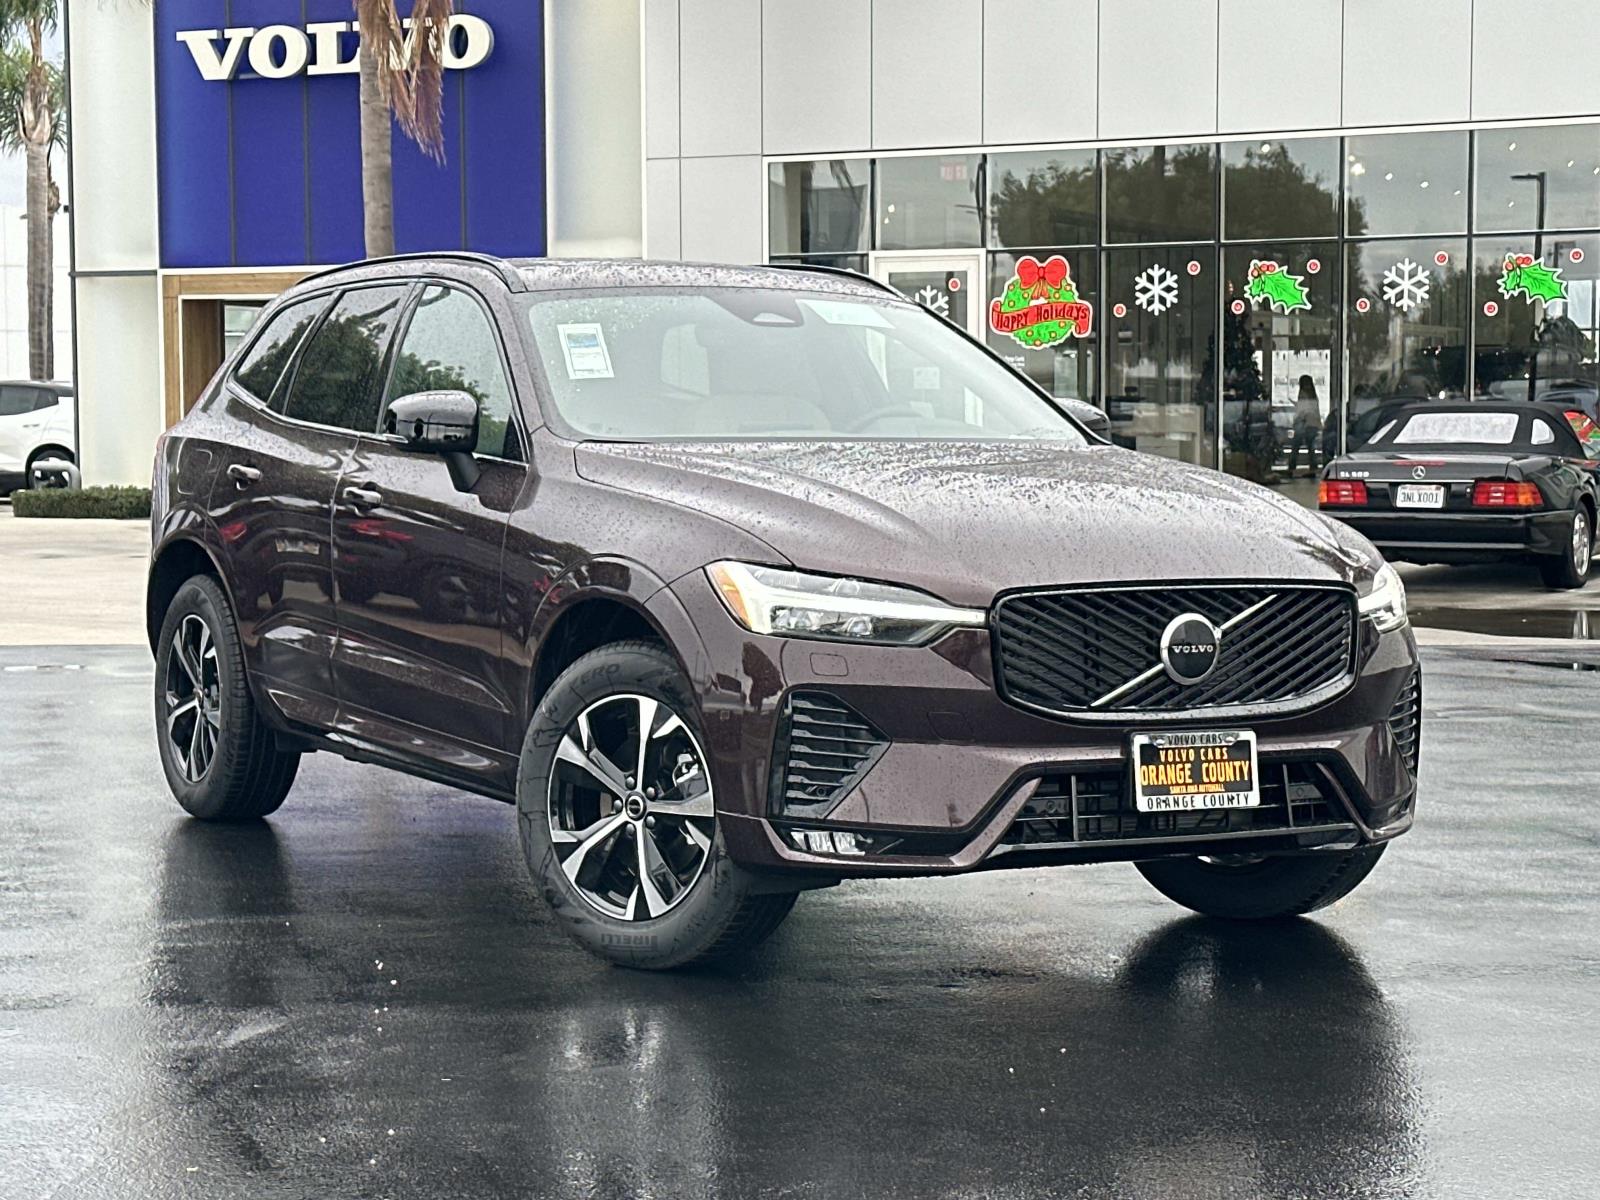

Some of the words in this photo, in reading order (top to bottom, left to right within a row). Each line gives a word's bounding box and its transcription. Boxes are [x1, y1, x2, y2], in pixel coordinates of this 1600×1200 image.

[176, 14, 493, 80] VOLVO
[1036, 303, 1088, 321] Holidays
[1172, 645, 1214, 654] VOLVO
[1167, 735, 1197, 745] VOLVO
[1200, 733, 1223, 743] CARS
[1159, 748, 1195, 762] VOLVO
[1200, 747, 1228, 760] CARS
[1140, 763, 1193, 786] ORANGE
[1201, 761, 1250, 782] COUNTY
[1147, 795, 1195, 810] ORANGE
[1203, 793, 1249, 807] COUNTY
